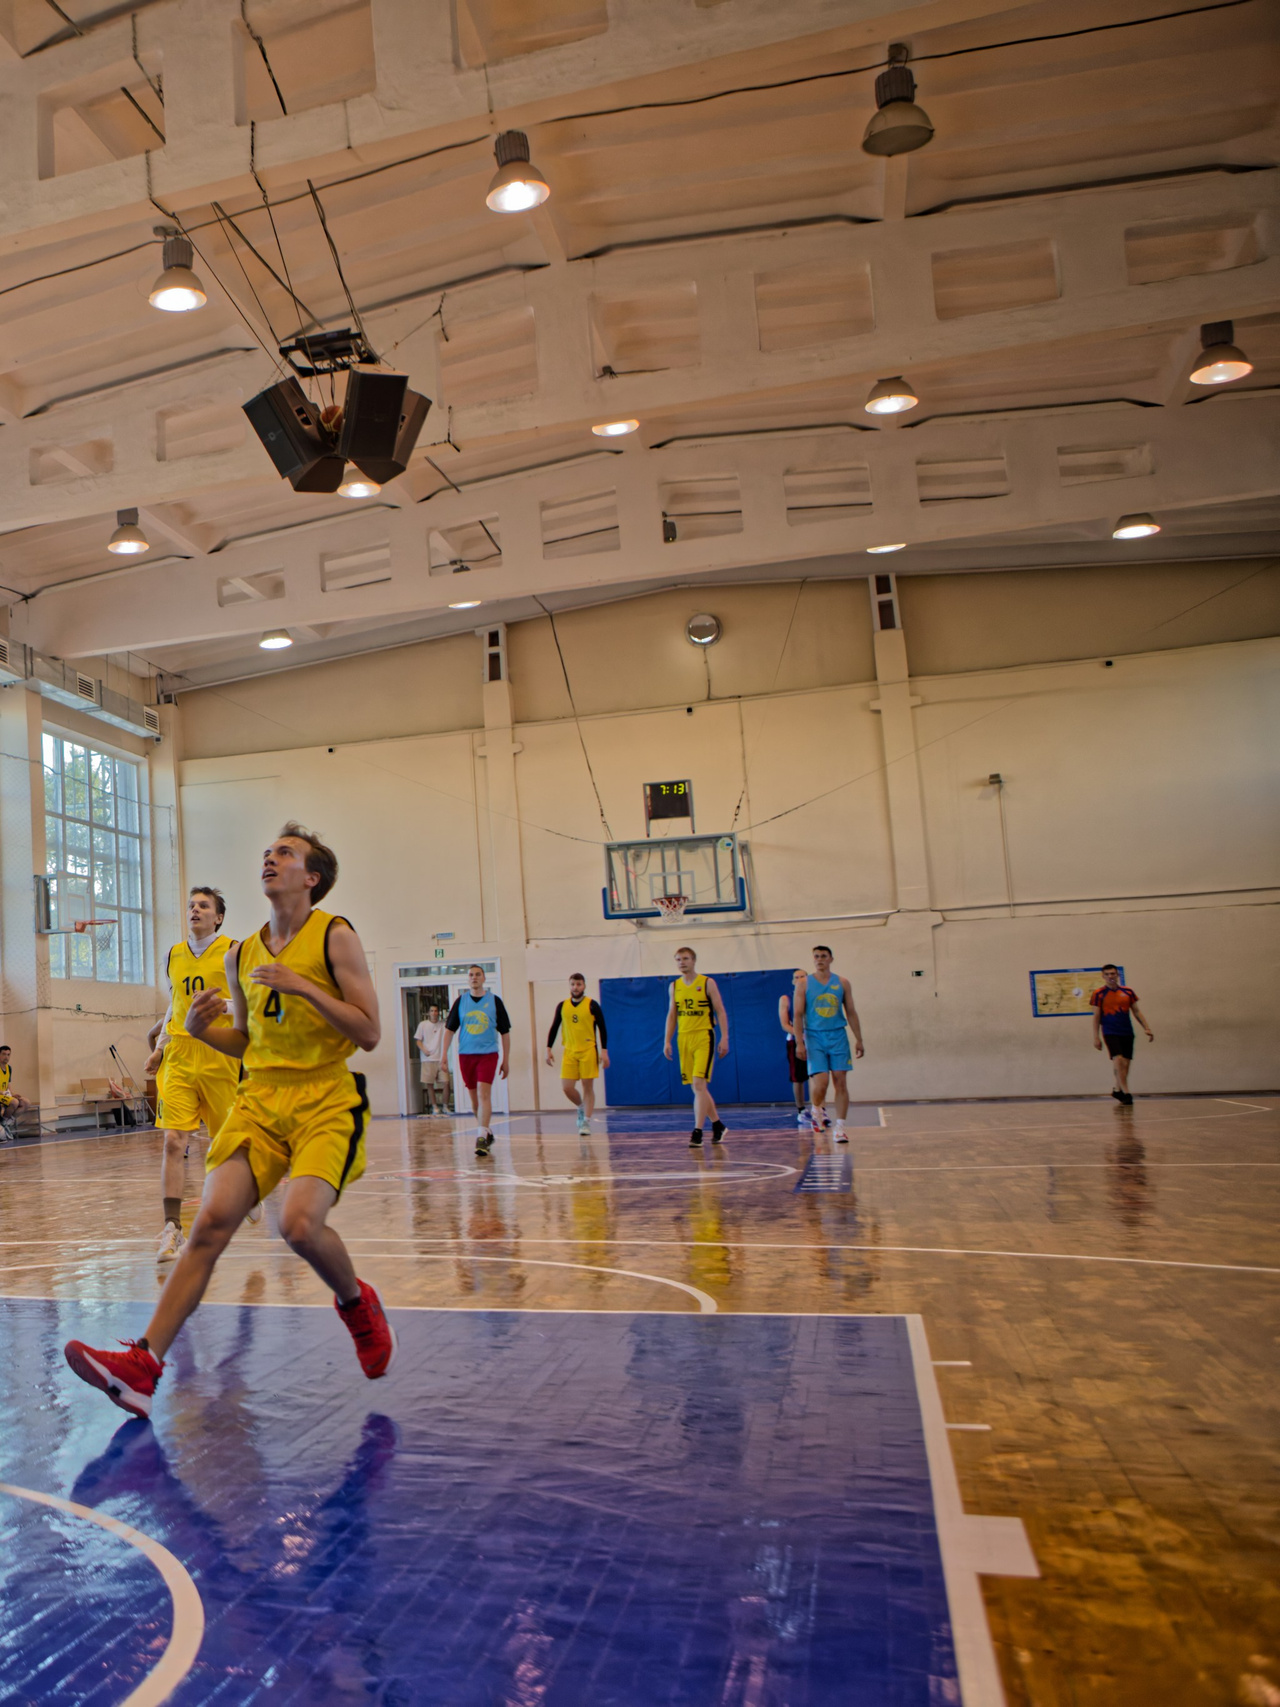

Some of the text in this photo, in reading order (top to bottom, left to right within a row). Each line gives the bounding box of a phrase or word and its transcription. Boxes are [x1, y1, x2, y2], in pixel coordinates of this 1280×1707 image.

[660, 783, 685, 795] 7:13
[182, 976, 205, 996] 10
[263, 989, 281, 1023] 4
[684, 998, 694, 1009] 12
[572, 1014, 579, 1023] 8
